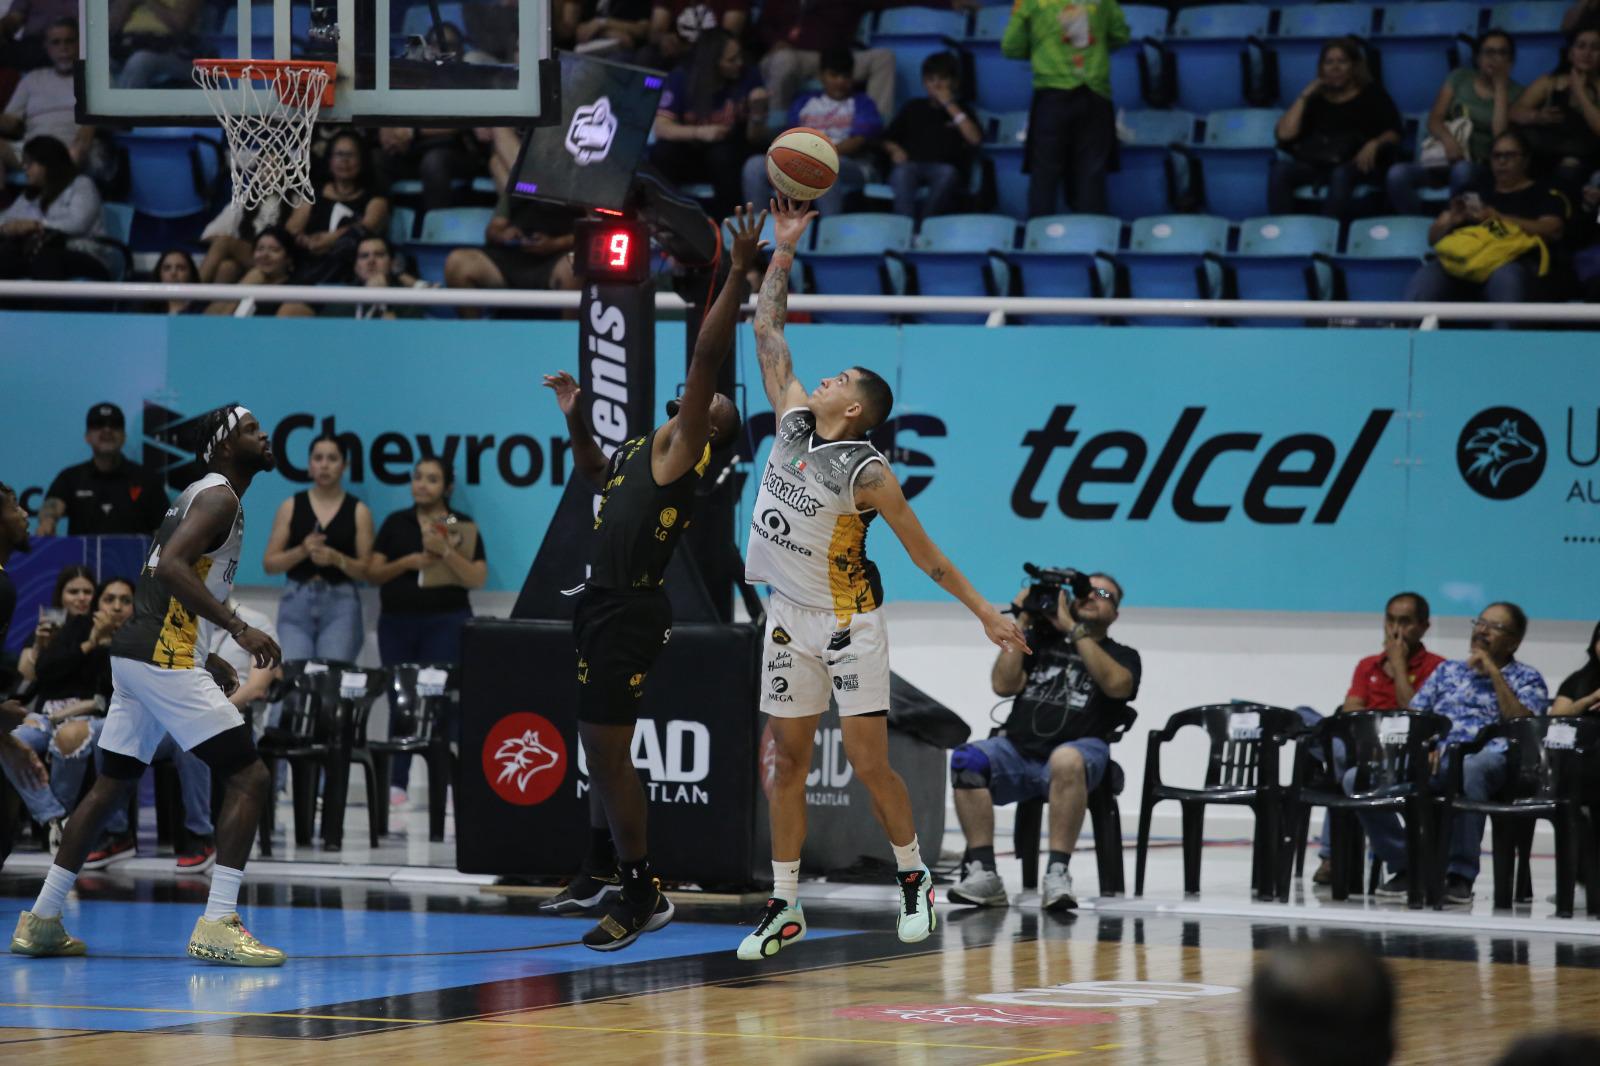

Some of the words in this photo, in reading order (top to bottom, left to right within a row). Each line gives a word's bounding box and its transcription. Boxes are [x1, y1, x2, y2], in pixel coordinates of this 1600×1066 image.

[610, 233, 630, 266] 9
[1010, 405, 1395, 524] telcel
[751, 520, 769, 539] anco
[770, 534, 813, 557] Azteca
[769, 693, 793, 702] MEGA
[577, 718, 710, 782] AD
[576, 780, 709, 804] MTLAN
